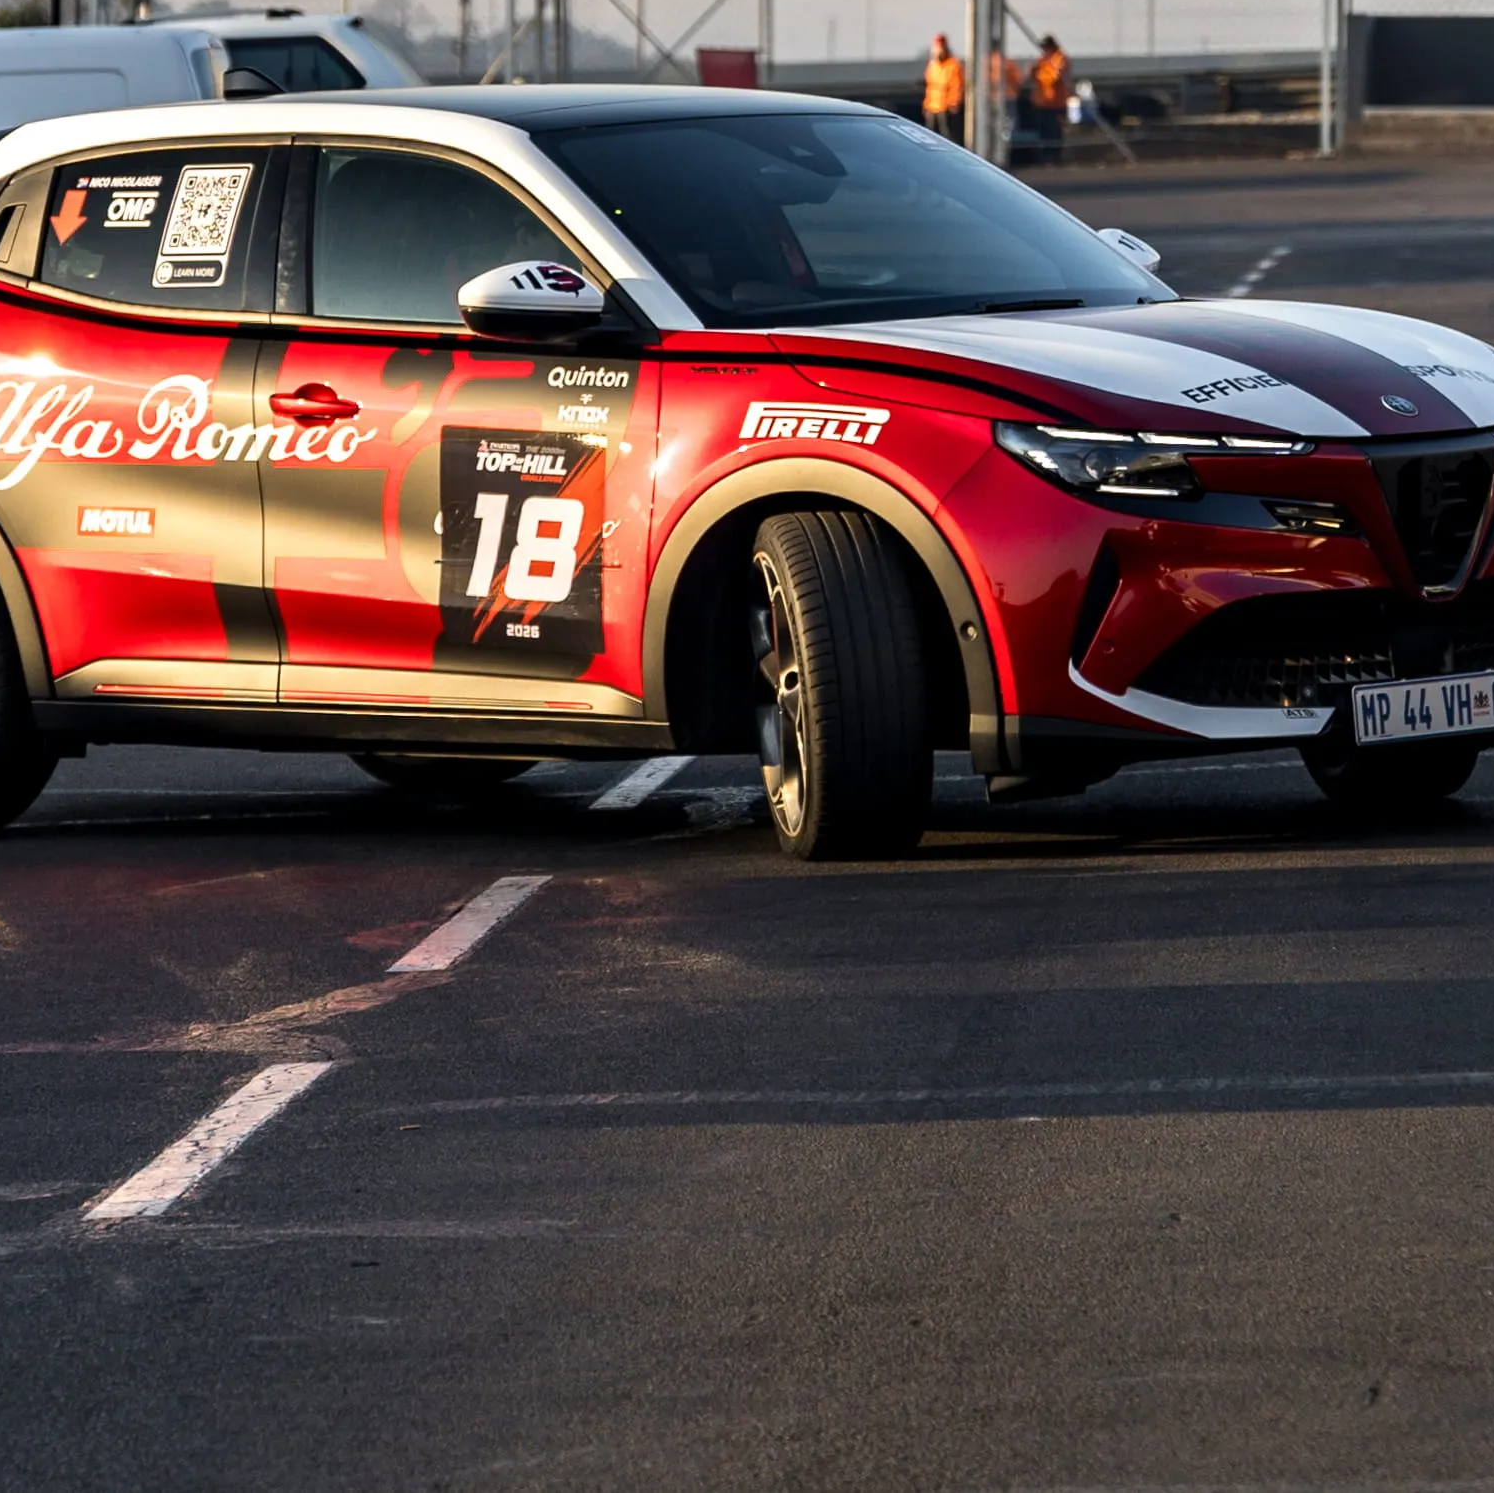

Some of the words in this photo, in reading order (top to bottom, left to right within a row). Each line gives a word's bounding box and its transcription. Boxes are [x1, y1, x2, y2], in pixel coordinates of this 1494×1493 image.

[107, 198, 156, 221] OMP
[173, 267, 195, 278] LEARN
[196, 266, 216, 278] MORE
[548, 366, 629, 389] Quinton
[128, 374, 378, 463] Romeo
[739, 402, 891, 445] PIRELLI
[476, 452, 517, 473] TOP
[521, 454, 567, 475] HILL
[81, 509, 154, 535] MOTUL
[466, 493, 585, 602] 18
[506, 623, 540, 638] 2026
[1360, 692, 1391, 737] MP
[1403, 687, 1433, 732] 44
[1441, 682, 1473, 728] VH
